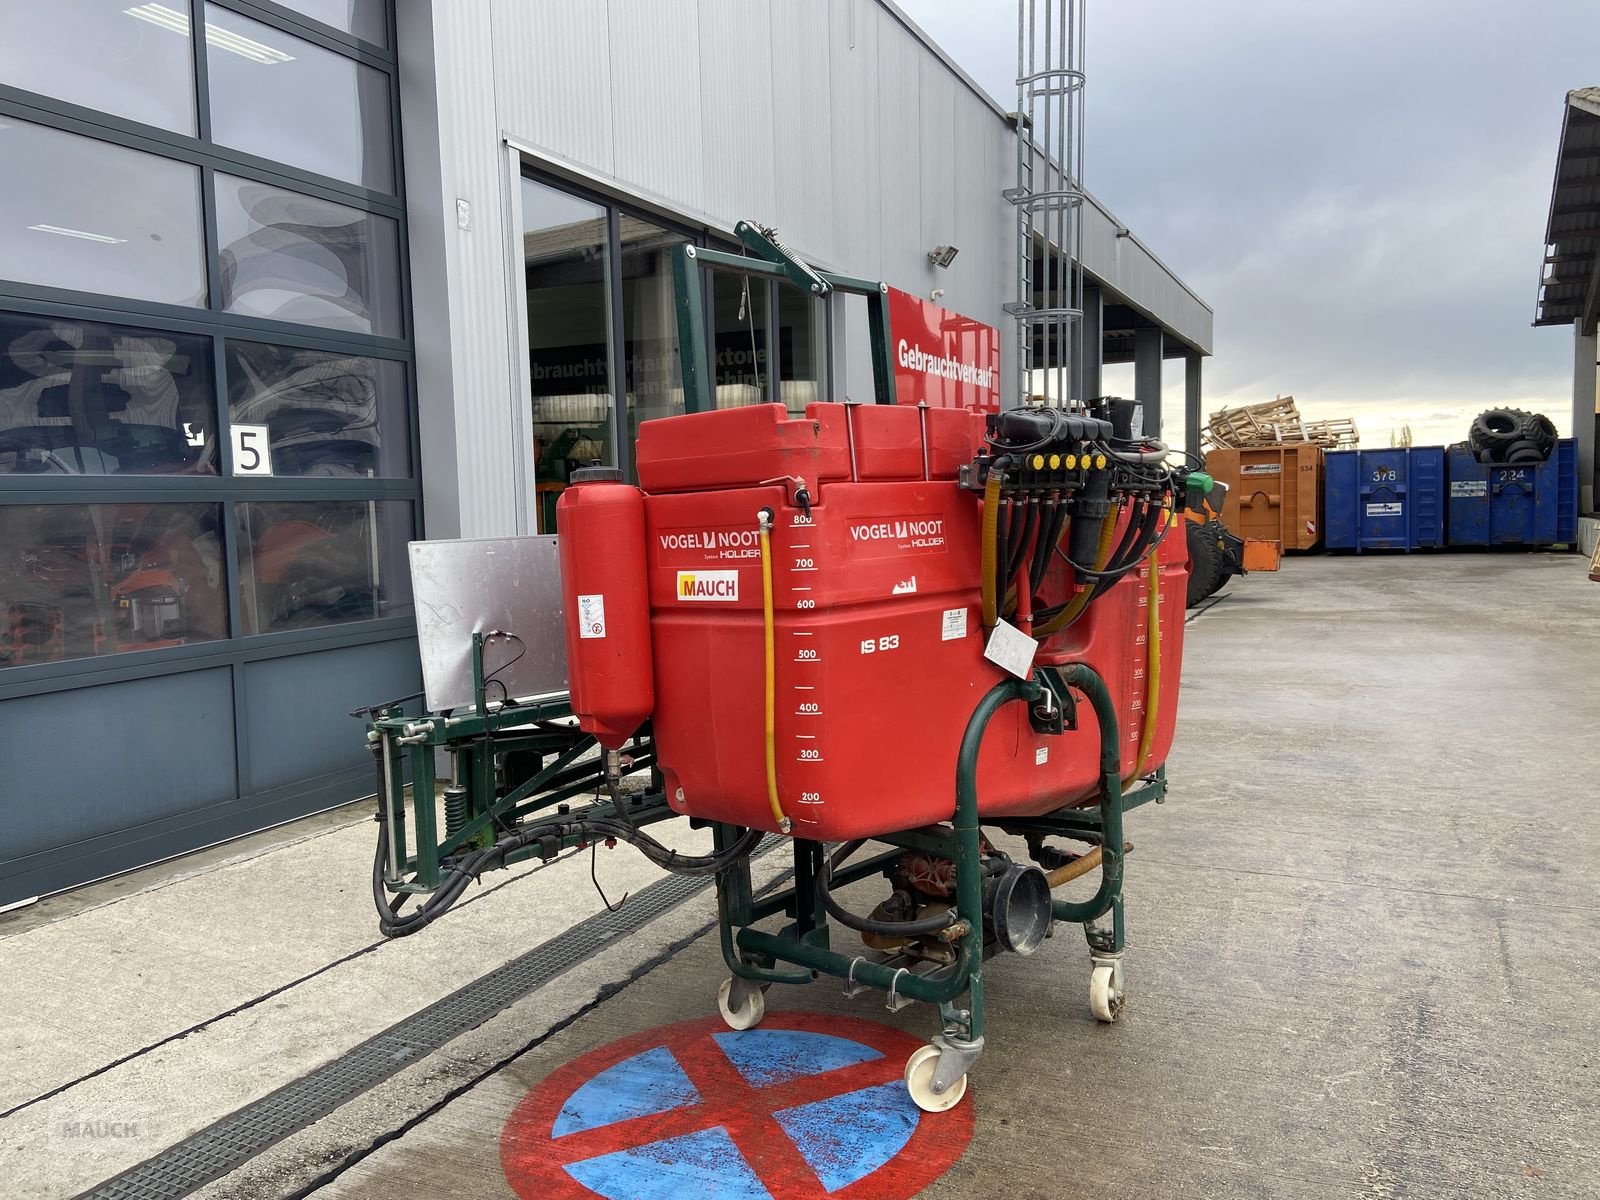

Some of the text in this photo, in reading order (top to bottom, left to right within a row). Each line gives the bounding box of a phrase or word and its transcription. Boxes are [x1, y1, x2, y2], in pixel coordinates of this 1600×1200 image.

[898, 338, 993, 389] Gebrauchtverkauf
[240, 431, 261, 471] 5
[1372, 470, 1396, 482] 378
[1500, 469, 1525, 481] 224
[793, 515, 812, 524] 800
[850, 520, 943, 541] VOGEL NOOT
[660, 530, 760, 549] VOGEL NOOT
[911, 537, 945, 548] HOLDER
[720, 549, 761, 559] HOLDER
[795, 558, 814, 568] 700
[683, 580, 735, 597] MAUCH
[796, 599, 815, 609] 600
[860, 634, 900, 655] IS 83
[798, 649, 817, 659] 500
[799, 703, 819, 712] 400
[800, 749, 819, 759] 300
[801, 792, 820, 801] 200
